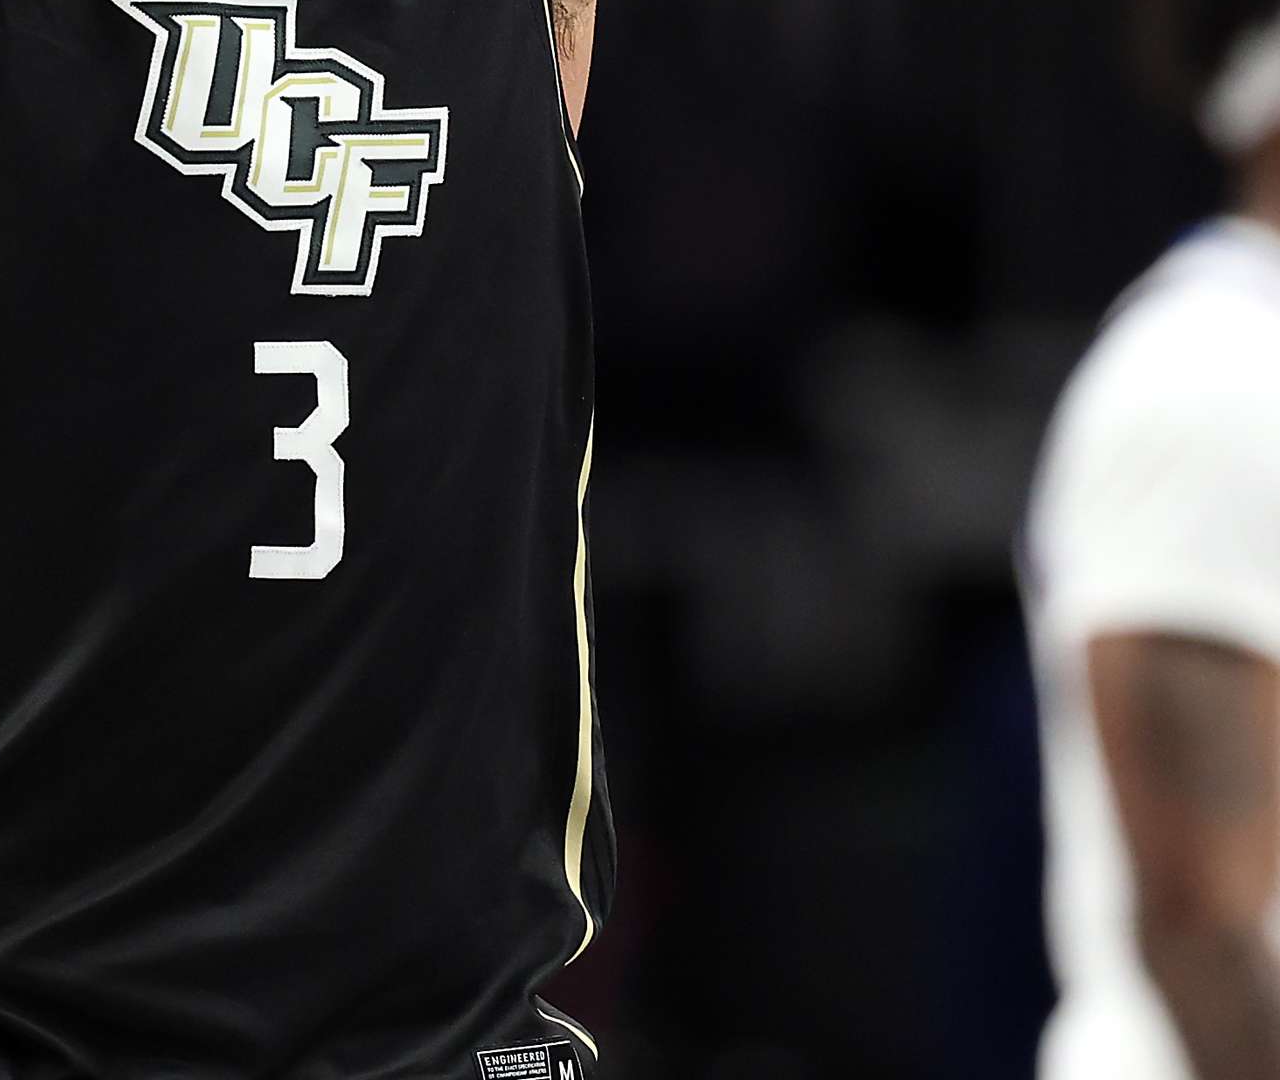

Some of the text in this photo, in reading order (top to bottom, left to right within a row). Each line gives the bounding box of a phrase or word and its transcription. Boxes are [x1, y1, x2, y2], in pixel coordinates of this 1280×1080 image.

[249, 341, 350, 579] 3
[484, 1051, 546, 1066] ENGINEERED
[559, 1059, 574, 1080] M
